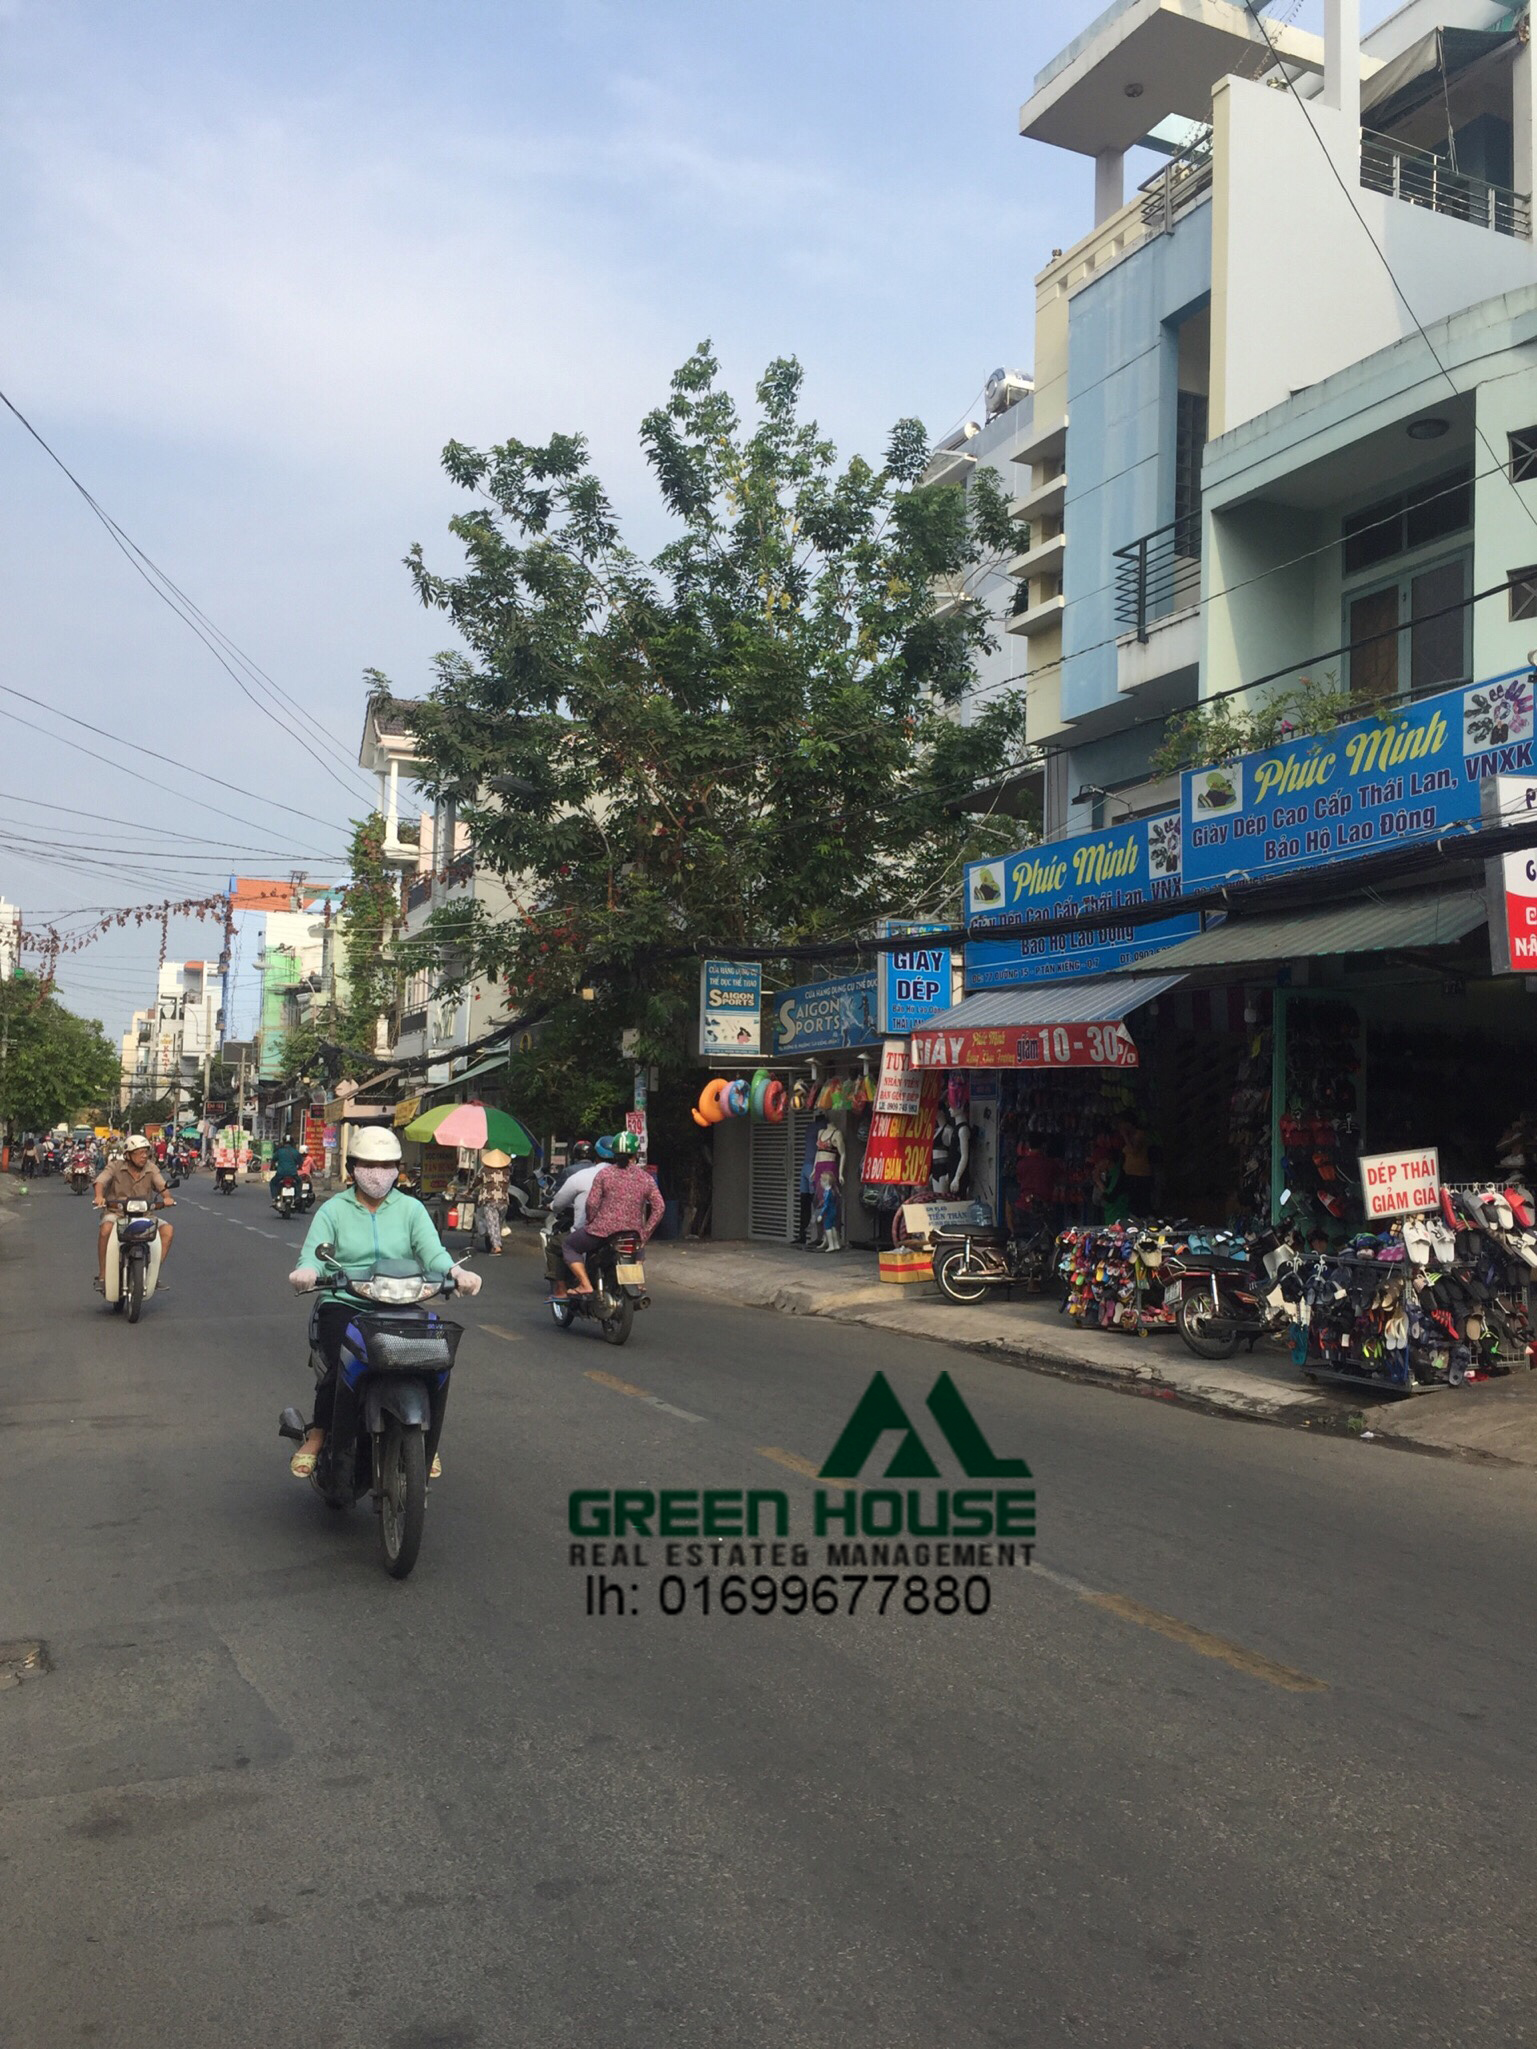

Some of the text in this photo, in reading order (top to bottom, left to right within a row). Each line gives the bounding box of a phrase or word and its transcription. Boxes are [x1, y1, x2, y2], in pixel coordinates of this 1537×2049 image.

[1254, 710, 1449, 805] Phúc Minh
[1192, 741, 1535, 848] Giày Dép Cao Cấp Thái Lan, VNXK
[1264, 836, 1300, 862] Bảo
[1305, 825, 1330, 854] Hộ
[1337, 819, 1374, 846] Lao
[1380, 806, 1437, 838] Động
[1012, 855, 1068, 903] Phúc
[1072, 834, 1140, 886] Minh
[895, 976, 940, 1002] DÉP
[911, 1032, 965, 1065] GIÀY
[1039, 1027, 1071, 1063] 10
[1086, 1025, 1137, 1065] 30%
[902, 1145, 930, 1183] 30%
[1367, 1155, 1436, 1186] DÉP THÁI
[1372, 1182, 1437, 1214] GIẢM GIÁ
